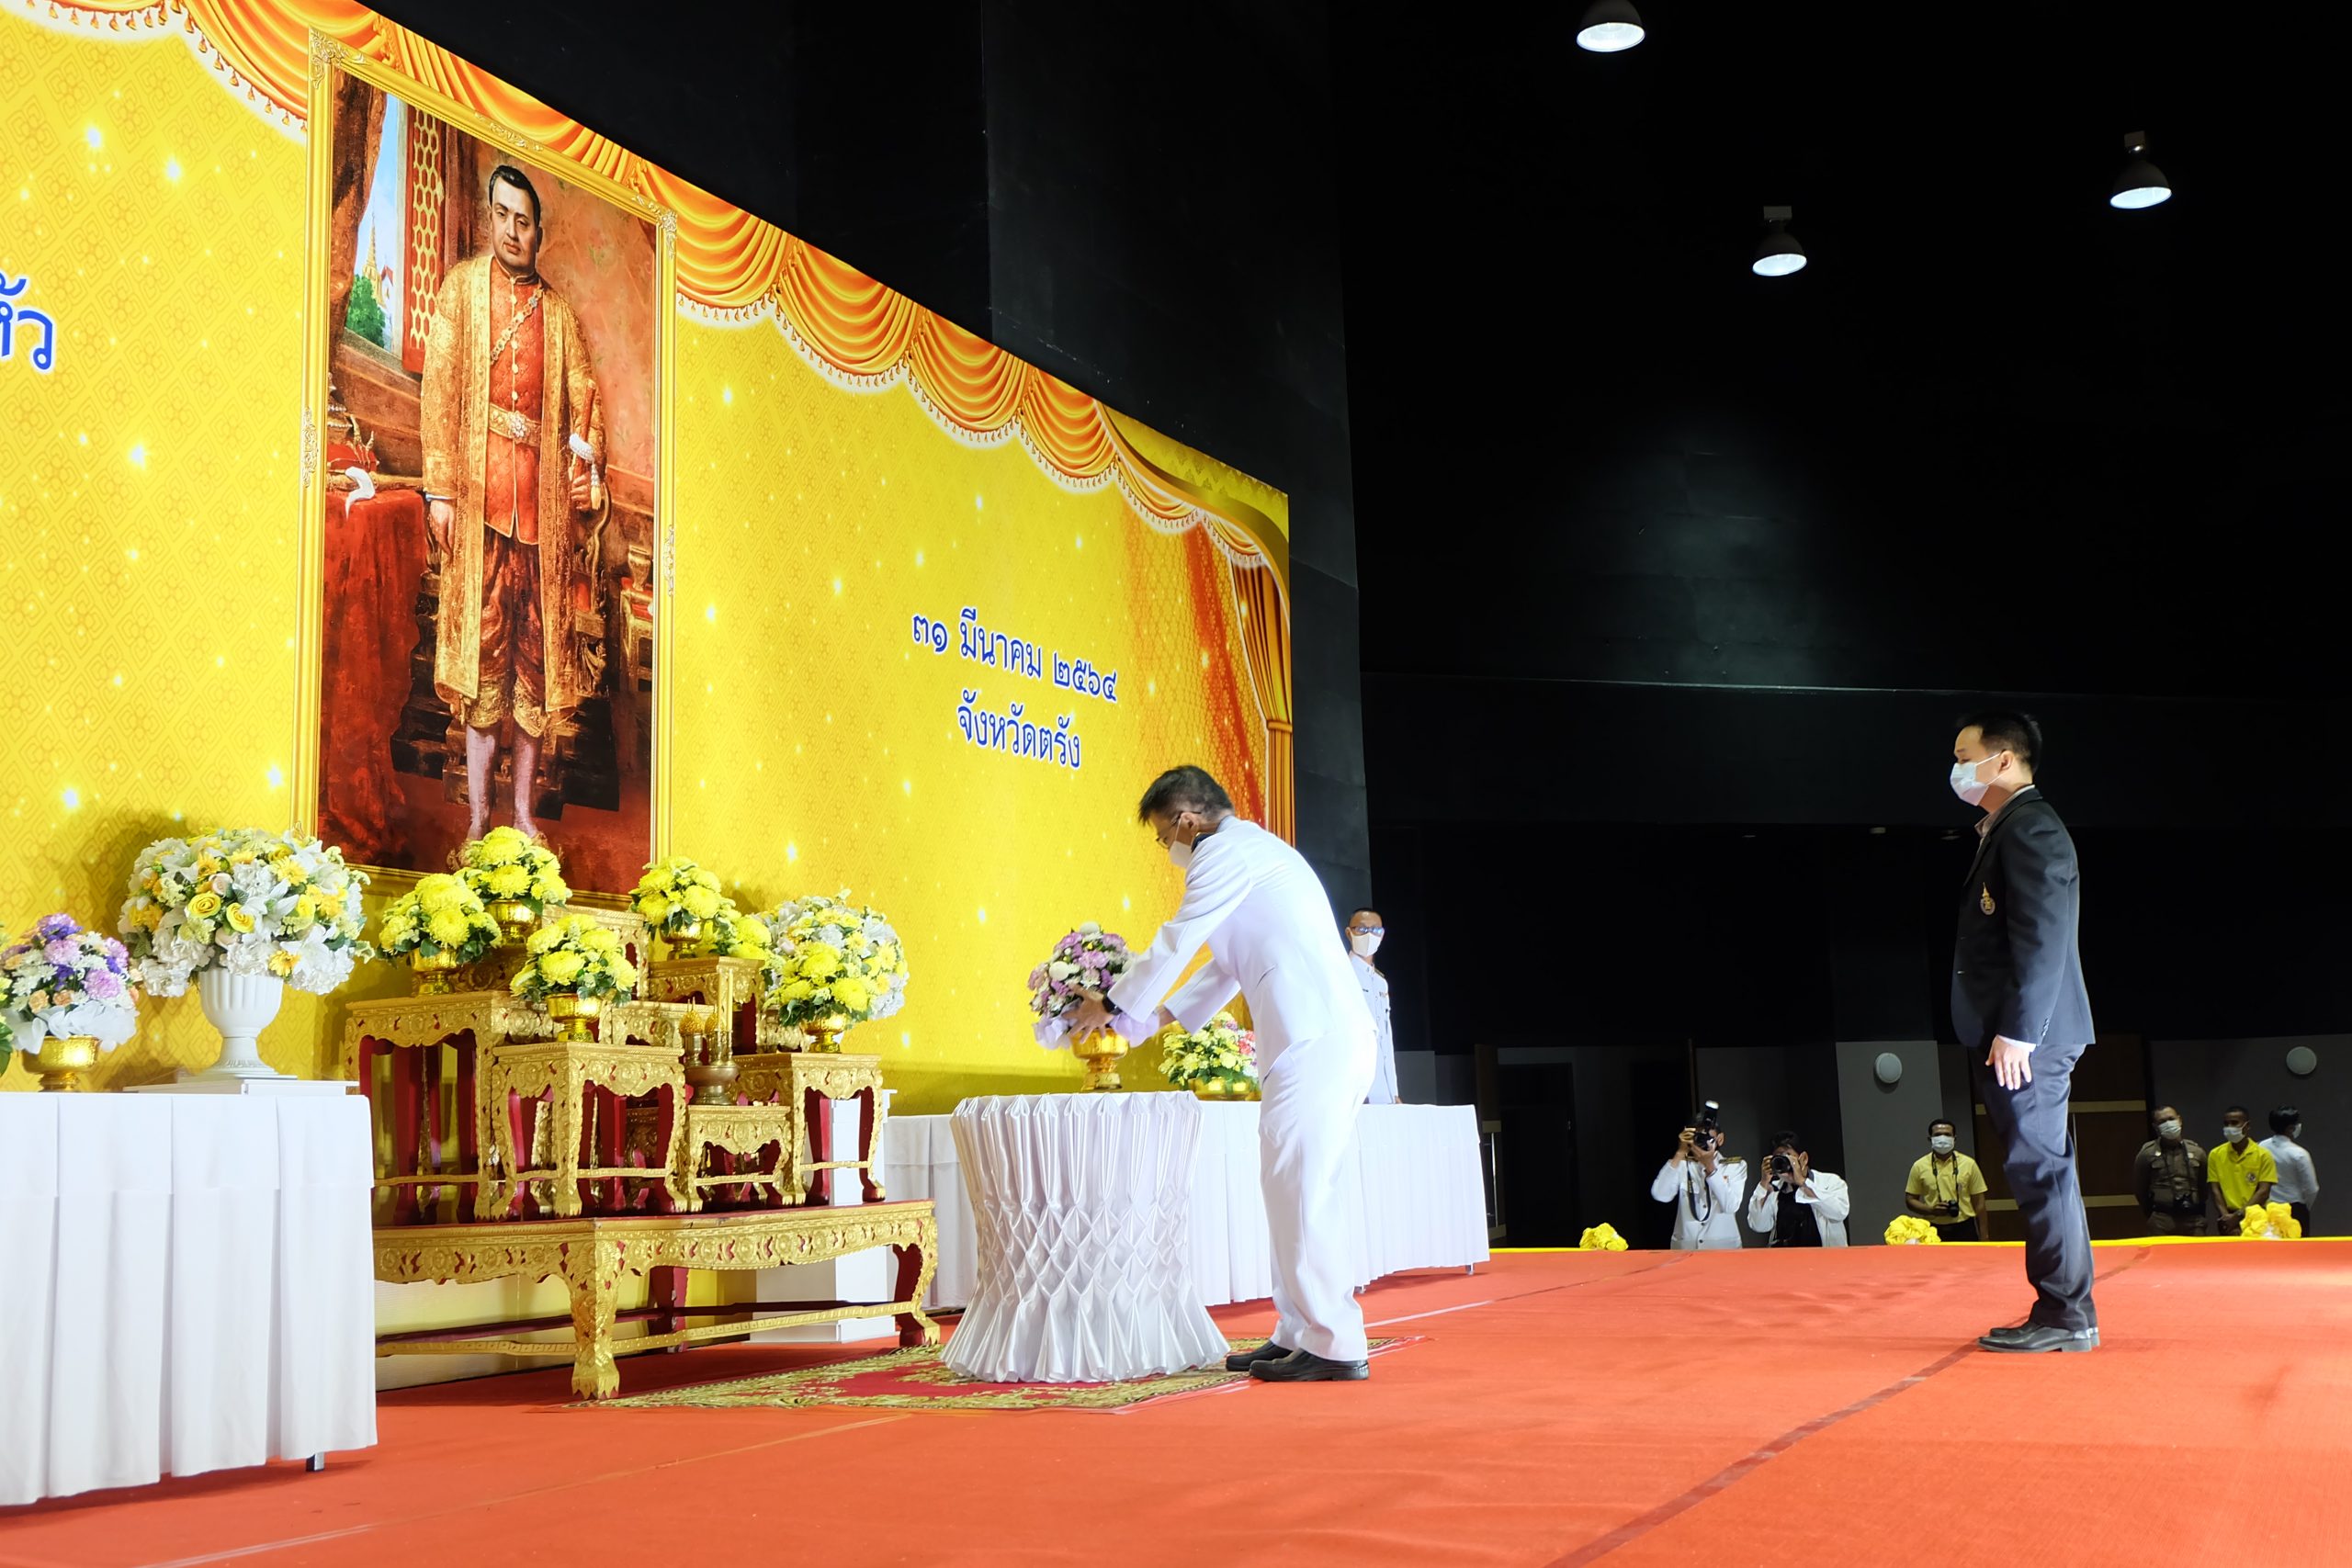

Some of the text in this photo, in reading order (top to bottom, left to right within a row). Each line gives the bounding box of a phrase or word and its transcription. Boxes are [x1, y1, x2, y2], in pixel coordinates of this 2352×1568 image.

[0, 270, 54, 371] ัว
[912, 607, 1117, 702] ๓๑ มีนาคม ๒๕๖๔
[956, 689, 1080, 769] จังหวัดตรัง
